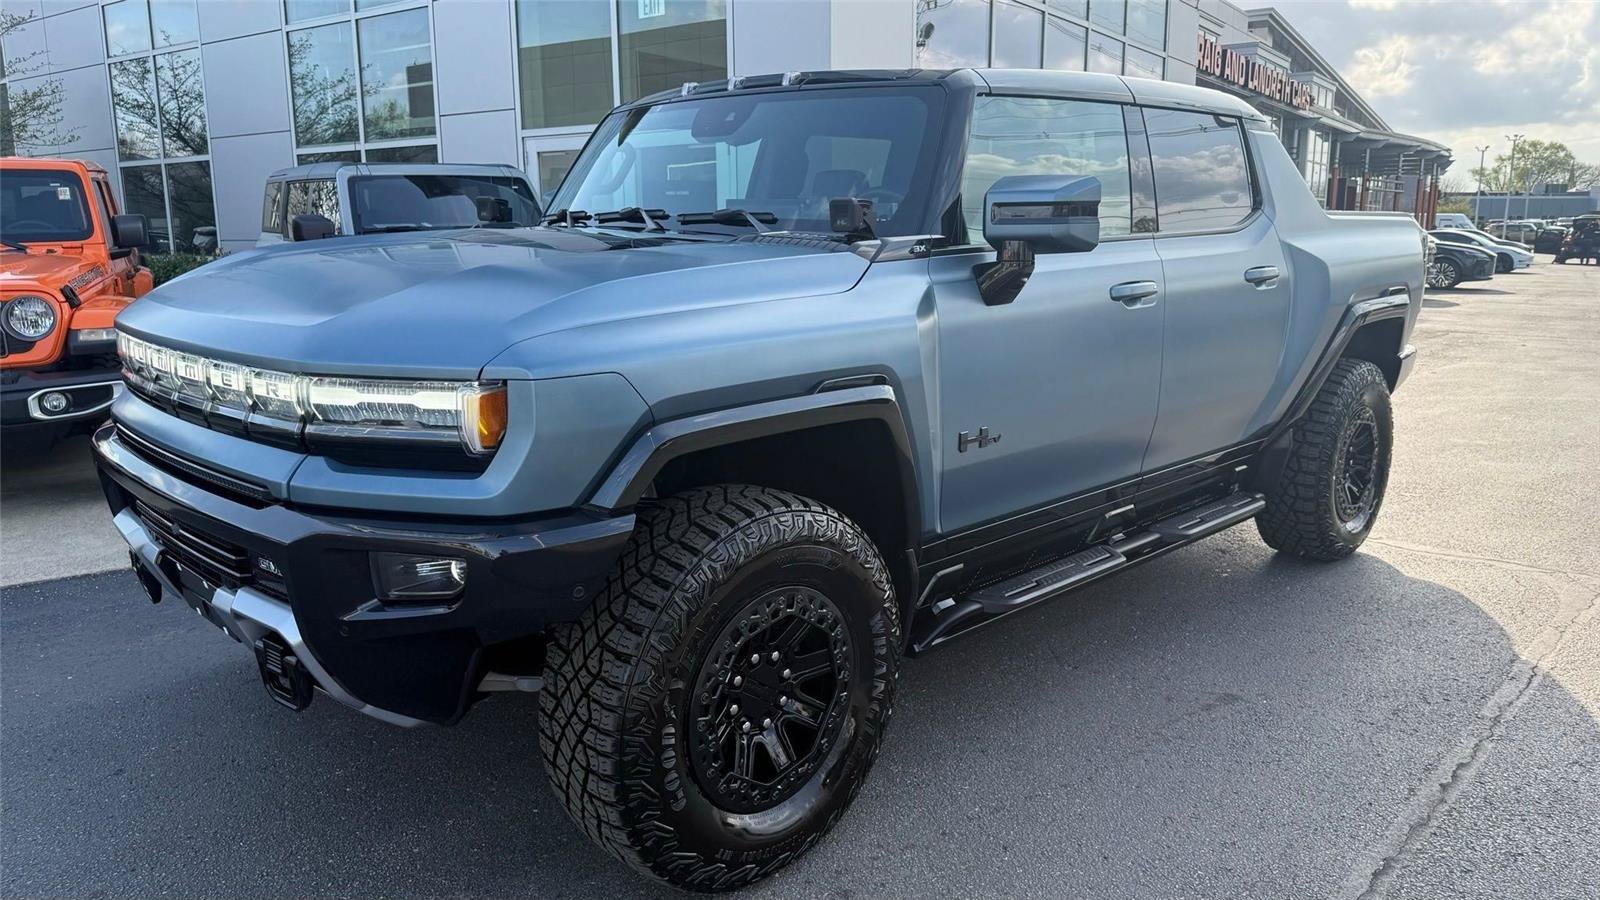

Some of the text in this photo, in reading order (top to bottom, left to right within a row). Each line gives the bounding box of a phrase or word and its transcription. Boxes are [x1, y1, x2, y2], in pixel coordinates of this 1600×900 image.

[1224, 49, 1246, 85] AND
[1248, 59, 1292, 104] LANDRETH
[1292, 79, 1311, 111] CARS
